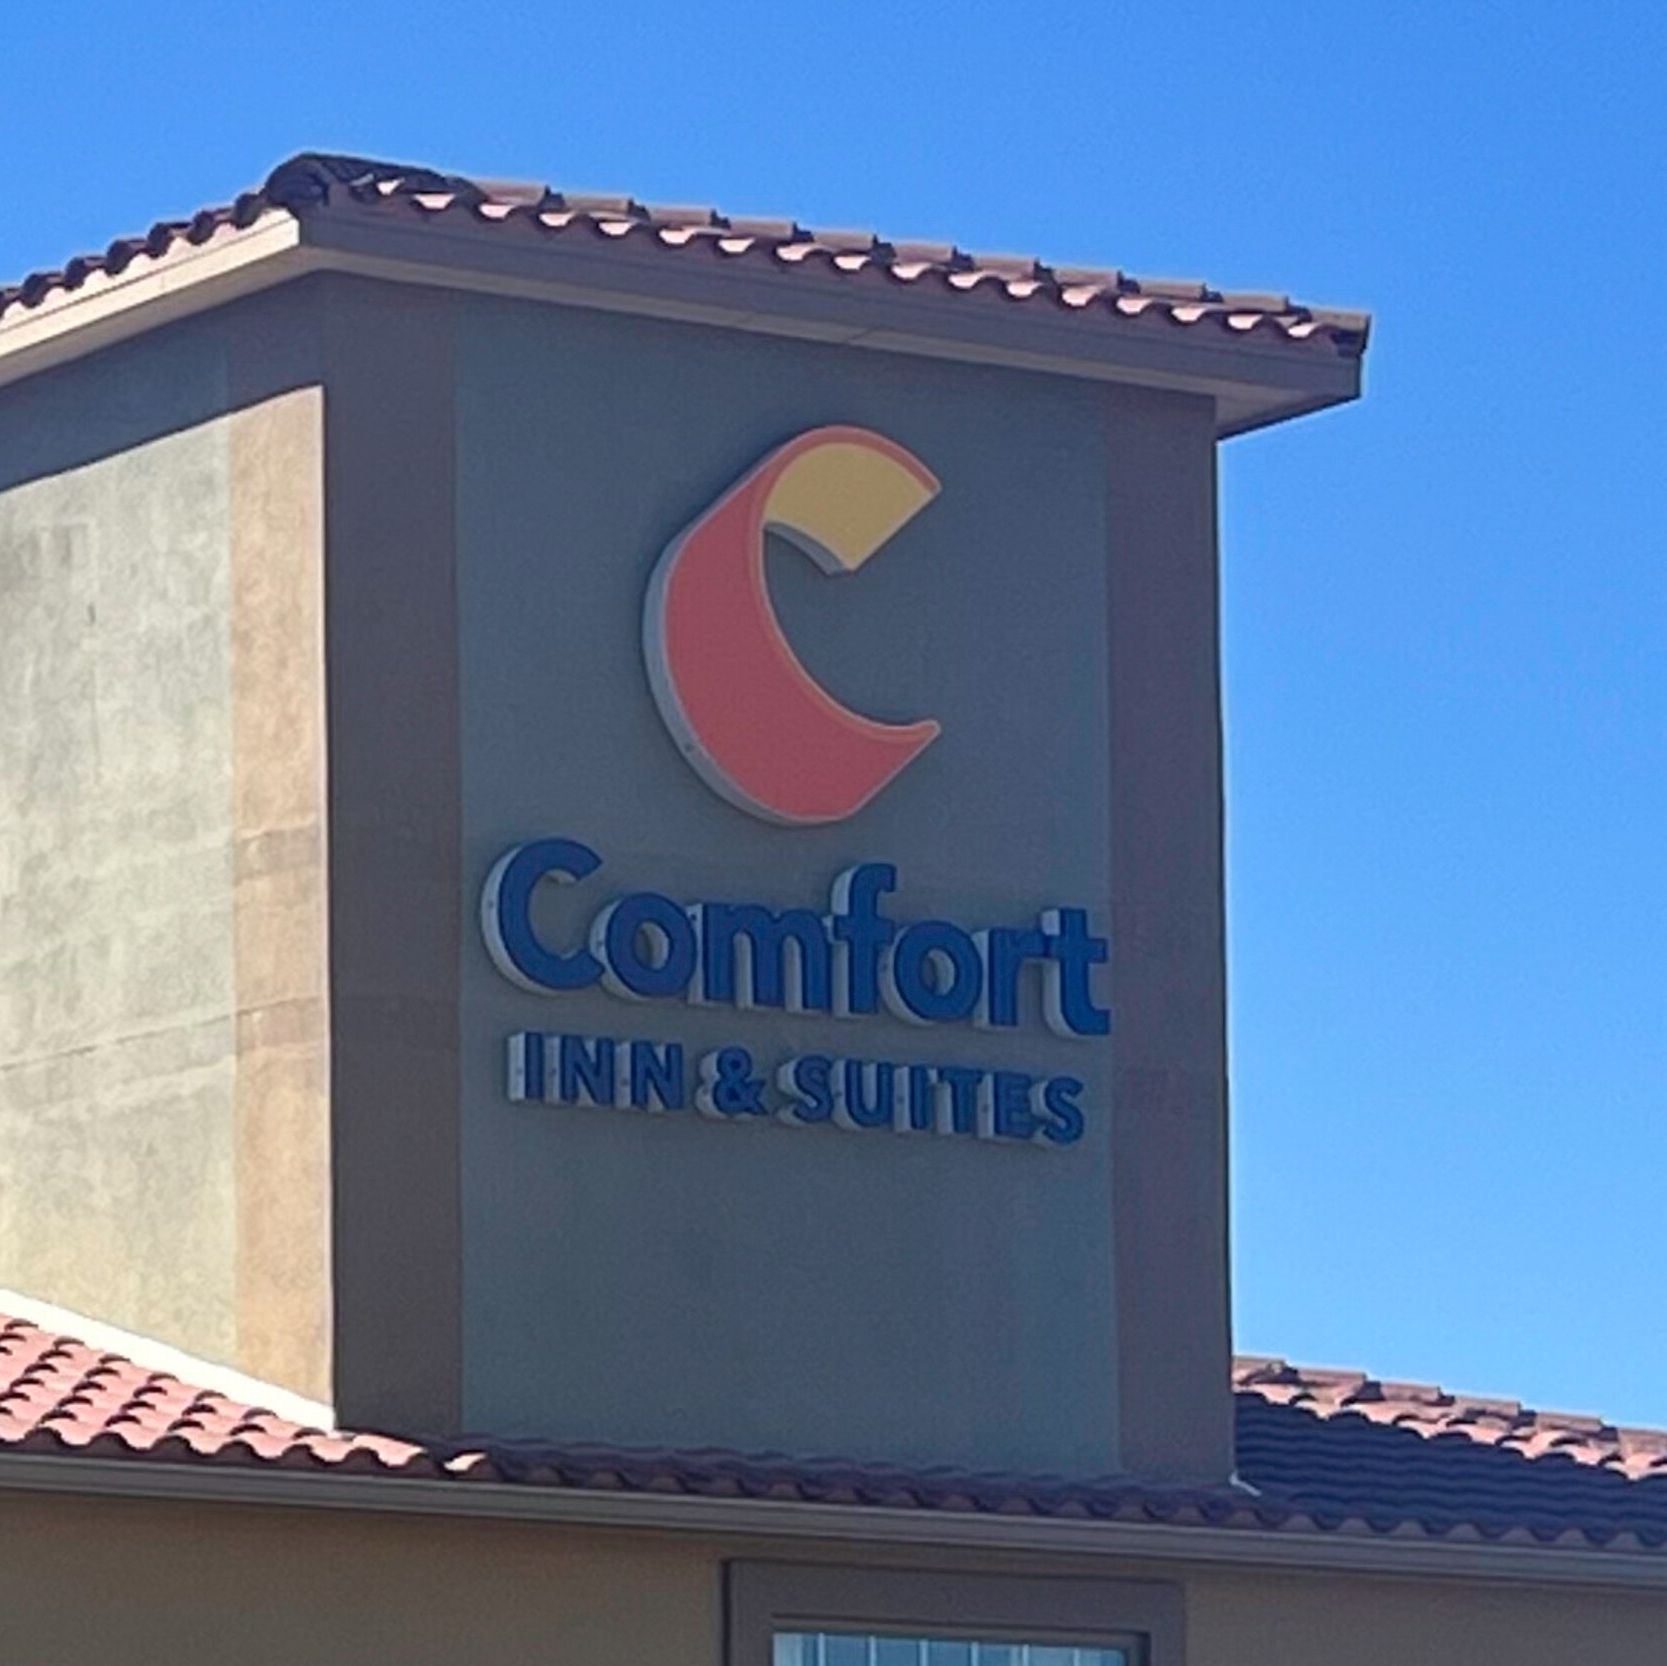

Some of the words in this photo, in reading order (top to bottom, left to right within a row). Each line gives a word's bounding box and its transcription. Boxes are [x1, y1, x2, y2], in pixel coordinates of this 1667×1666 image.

[481, 838, 1110, 1038] Comfort
[509, 1031, 684, 1113] INN
[695, 1046, 767, 1121] &
[777, 1055, 1085, 1146] SUITES
